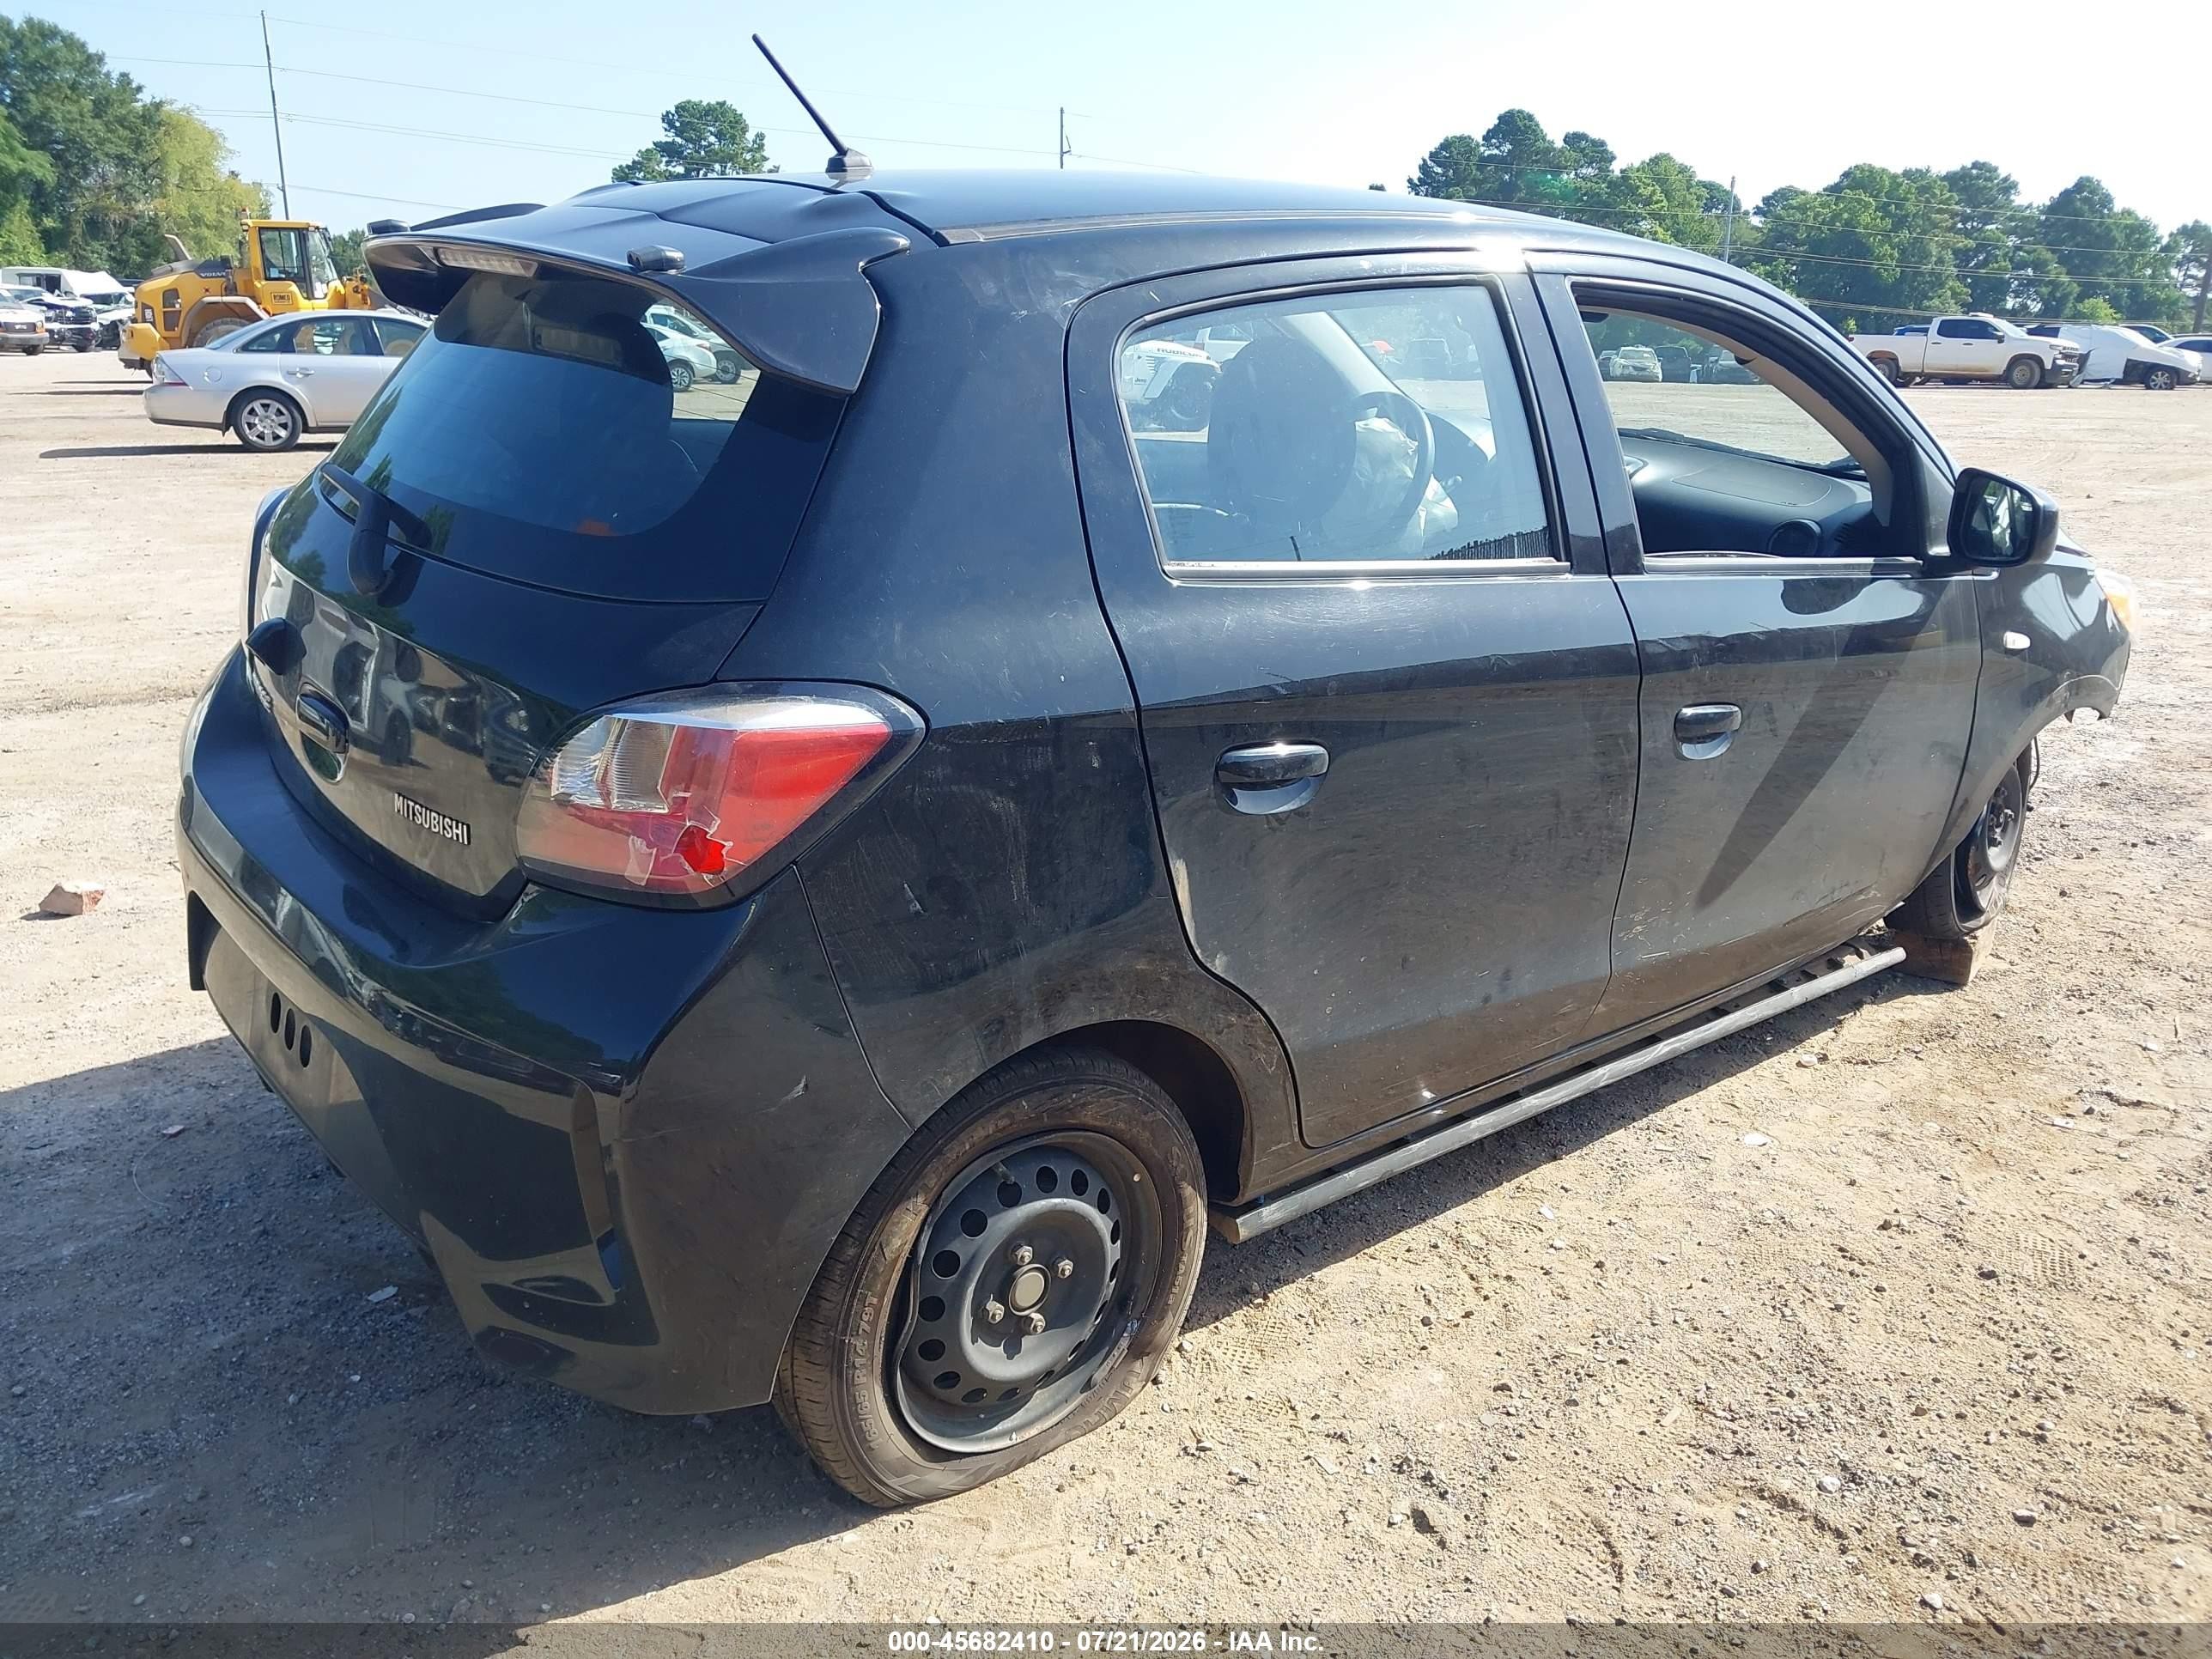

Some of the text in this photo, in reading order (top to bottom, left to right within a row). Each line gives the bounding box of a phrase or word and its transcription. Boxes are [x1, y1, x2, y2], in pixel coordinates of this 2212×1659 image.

[394, 793, 468, 845] MITSUBISHI
[854, 1291, 883, 1450] 165/65 R14 79T
